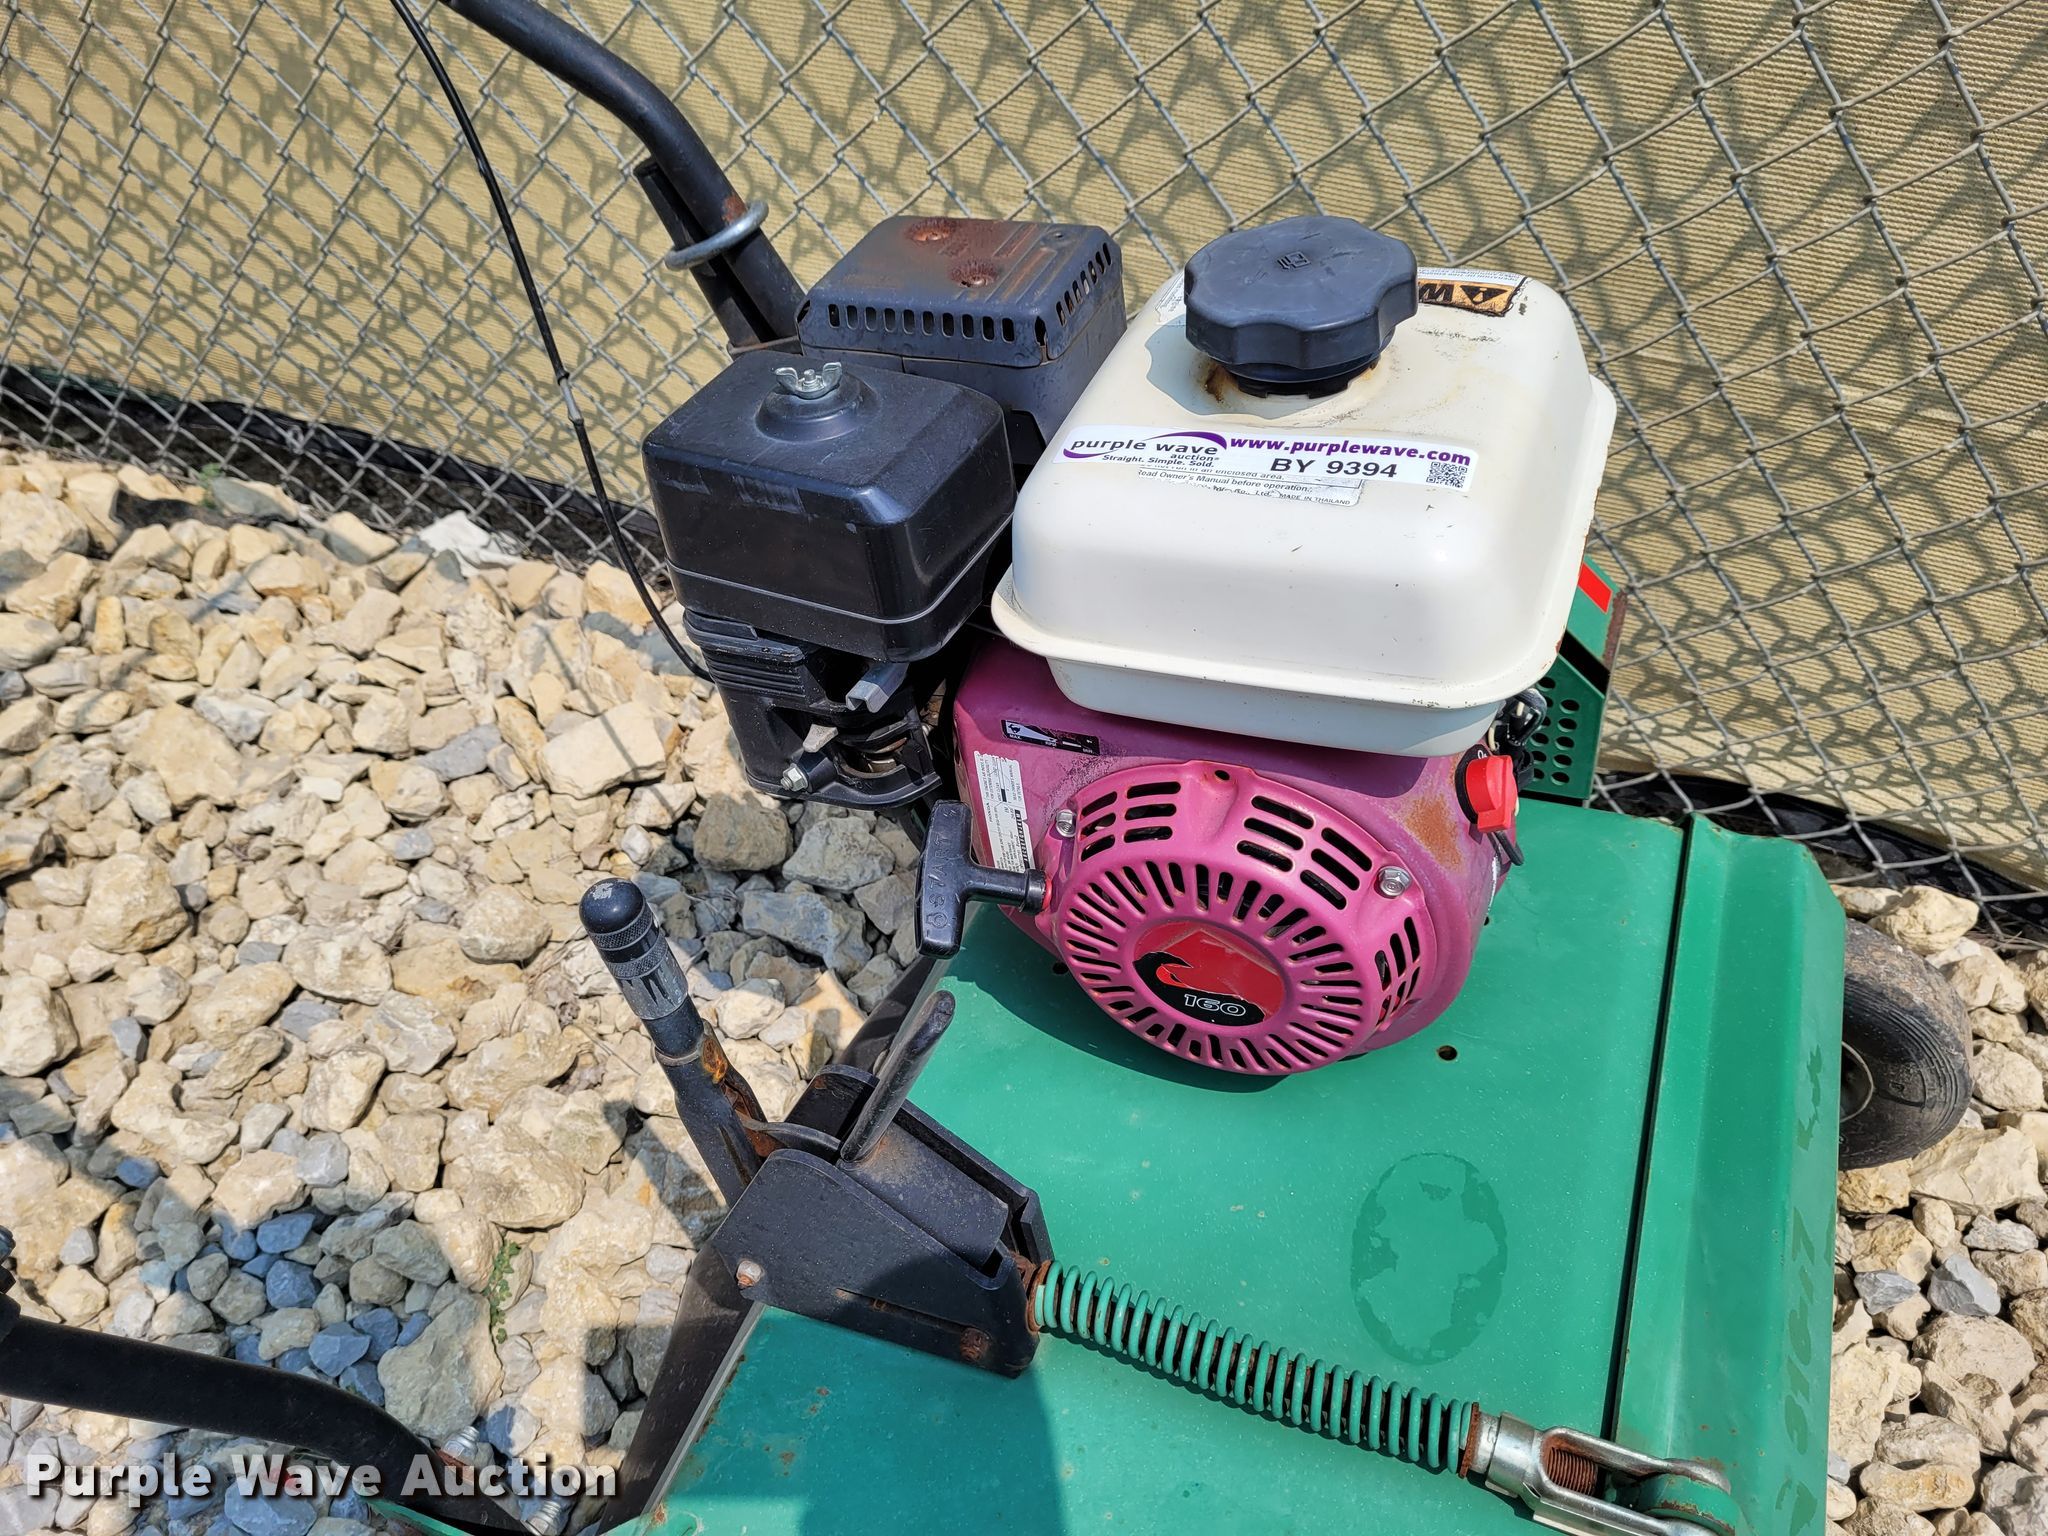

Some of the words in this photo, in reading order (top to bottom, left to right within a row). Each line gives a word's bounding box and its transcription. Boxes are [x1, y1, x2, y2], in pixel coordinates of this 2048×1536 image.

[1070, 439, 1146, 451] purple
[1156, 443, 1218, 455] wave
[1230, 437, 1471, 466] www.purplewave.com
[1102, 454, 1144, 463] Straight.
[1148, 457, 1185, 466] Simple.
[1188, 460, 1214, 468] Sold.
[1270, 458, 1316, 473] BY
[1325, 460, 1397, 478] 9394
[1160, 471, 1194, 481] Owner's
[1196, 475, 1230, 485] Manual
[1231, 478, 1262, 488] before
[1260, 472, 1284, 480] area.
[1315, 496, 1351, 505] THAILAND
[1184, 993, 1246, 1017] 160
